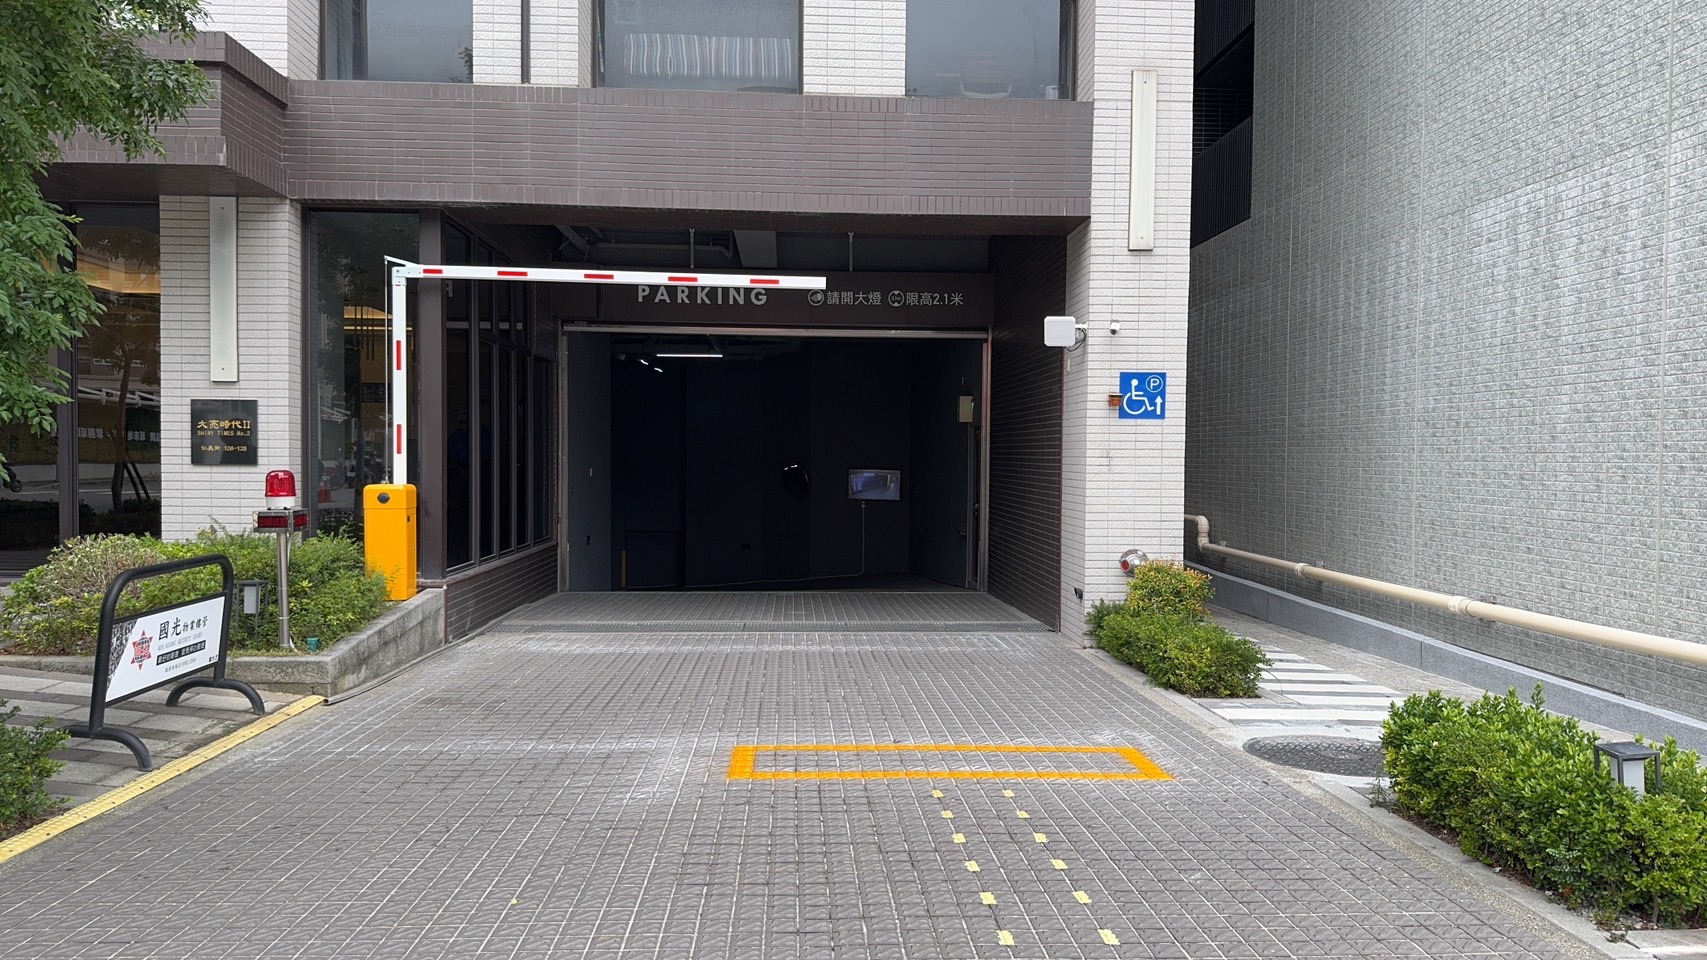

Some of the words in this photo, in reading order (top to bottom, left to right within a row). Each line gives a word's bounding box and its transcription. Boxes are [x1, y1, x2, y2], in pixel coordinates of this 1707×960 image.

[638, 285, 768, 305] PARKING
[826, 291, 882, 306] 請開大燈
[906, 291, 964, 306] 限高2.1米
[1150, 378, 1160, 390] P
